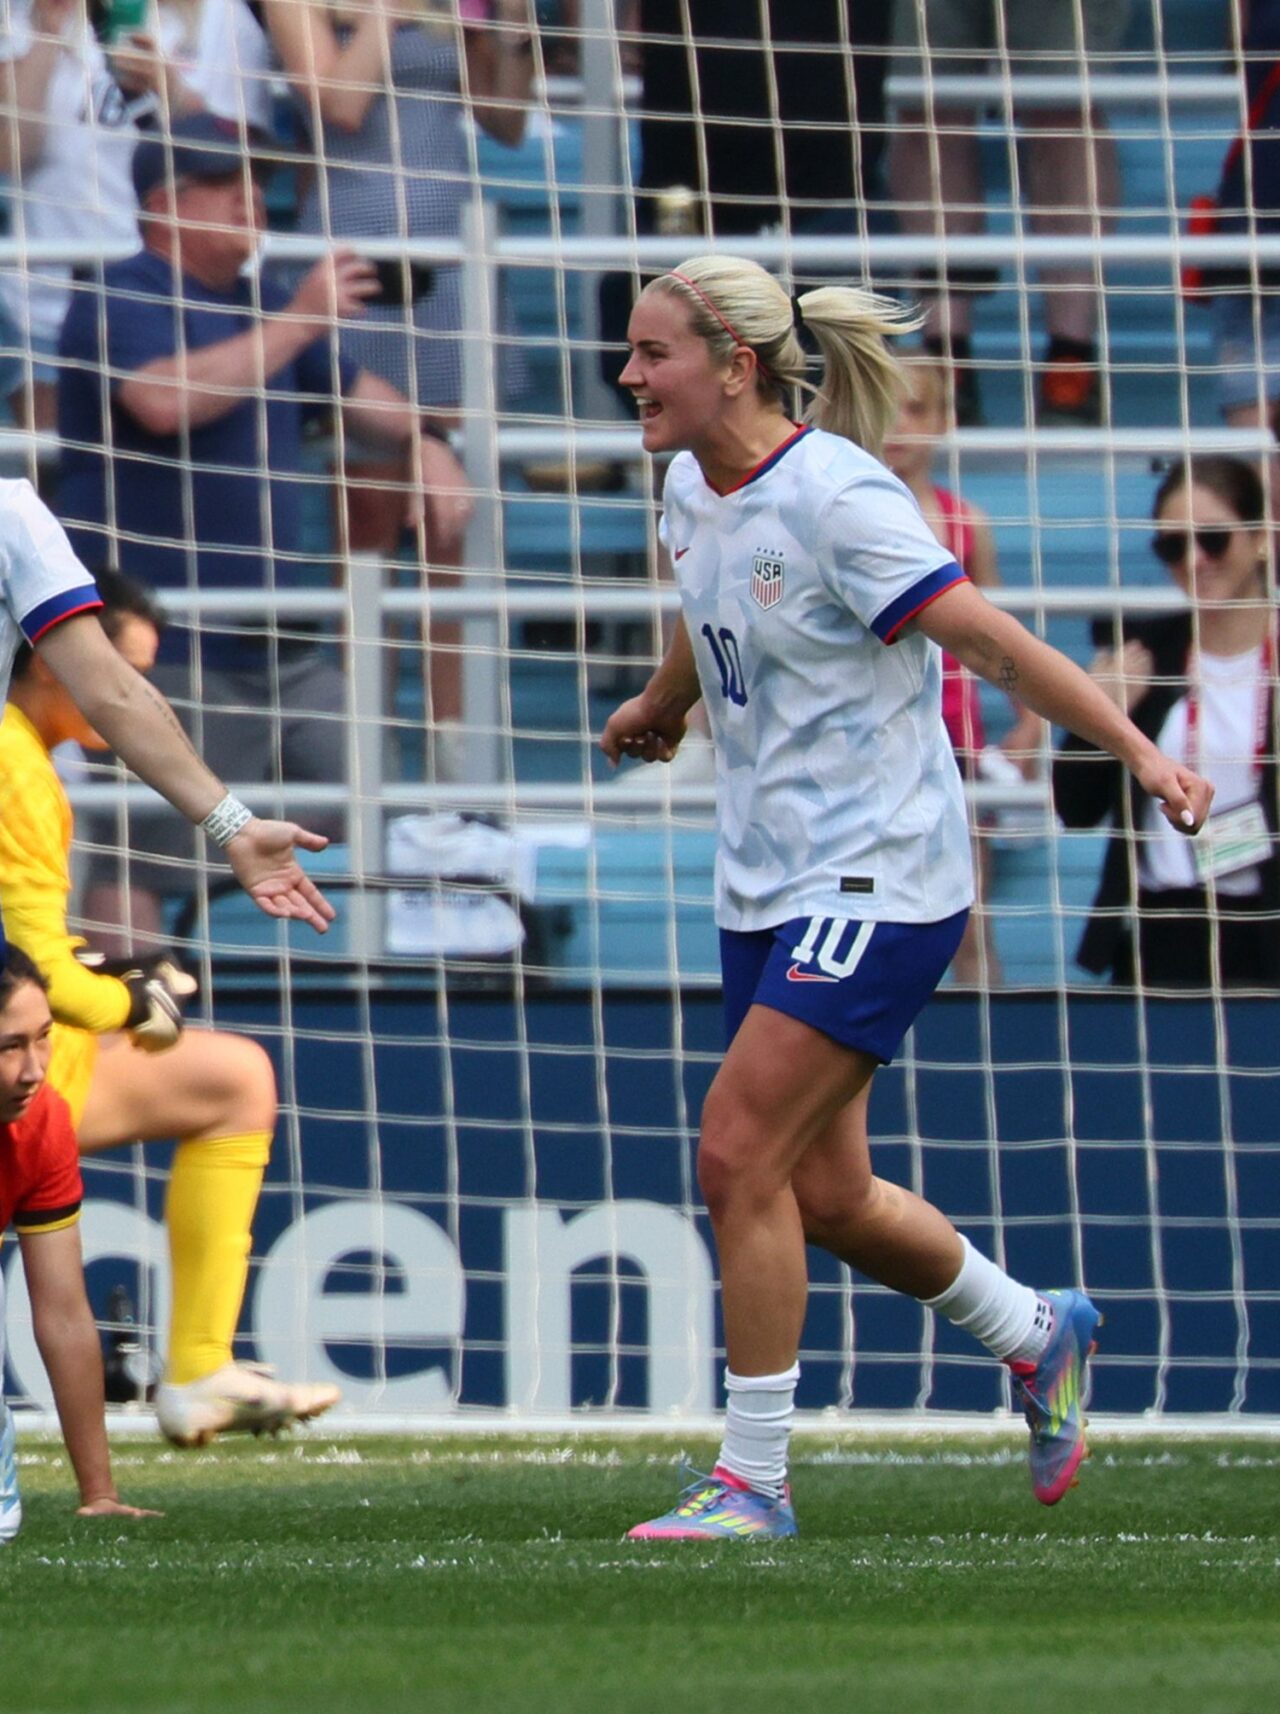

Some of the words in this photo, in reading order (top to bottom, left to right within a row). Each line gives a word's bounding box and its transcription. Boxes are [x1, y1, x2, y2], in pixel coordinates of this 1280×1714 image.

[754, 559, 782, 582] USA
[701, 623, 748, 708] 10
[790, 915, 877, 979] 10
